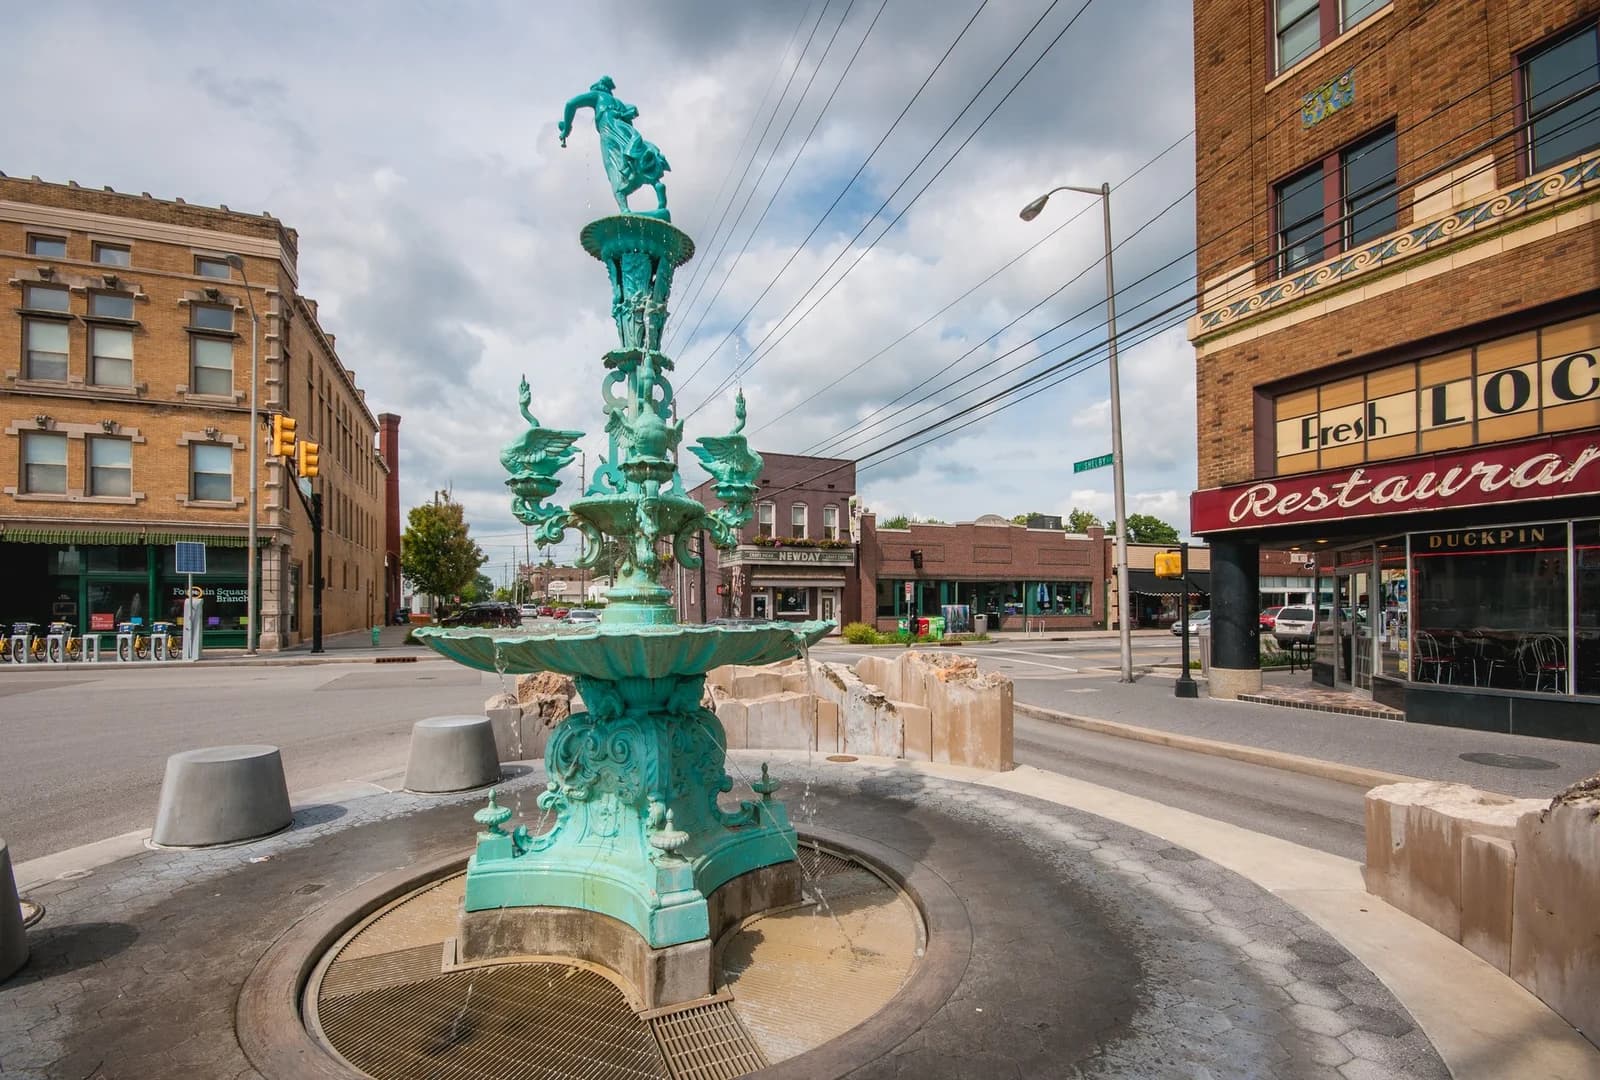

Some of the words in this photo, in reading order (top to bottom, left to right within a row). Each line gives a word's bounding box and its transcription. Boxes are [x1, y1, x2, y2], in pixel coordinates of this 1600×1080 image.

[1301, 402, 1387, 450] Fresh
[1432, 353, 1600, 427] LOC
[1429, 528, 1545, 549] DUCKPIN
[779, 552, 821, 561] NEWDAY
[216, 595, 249, 603] Branch
